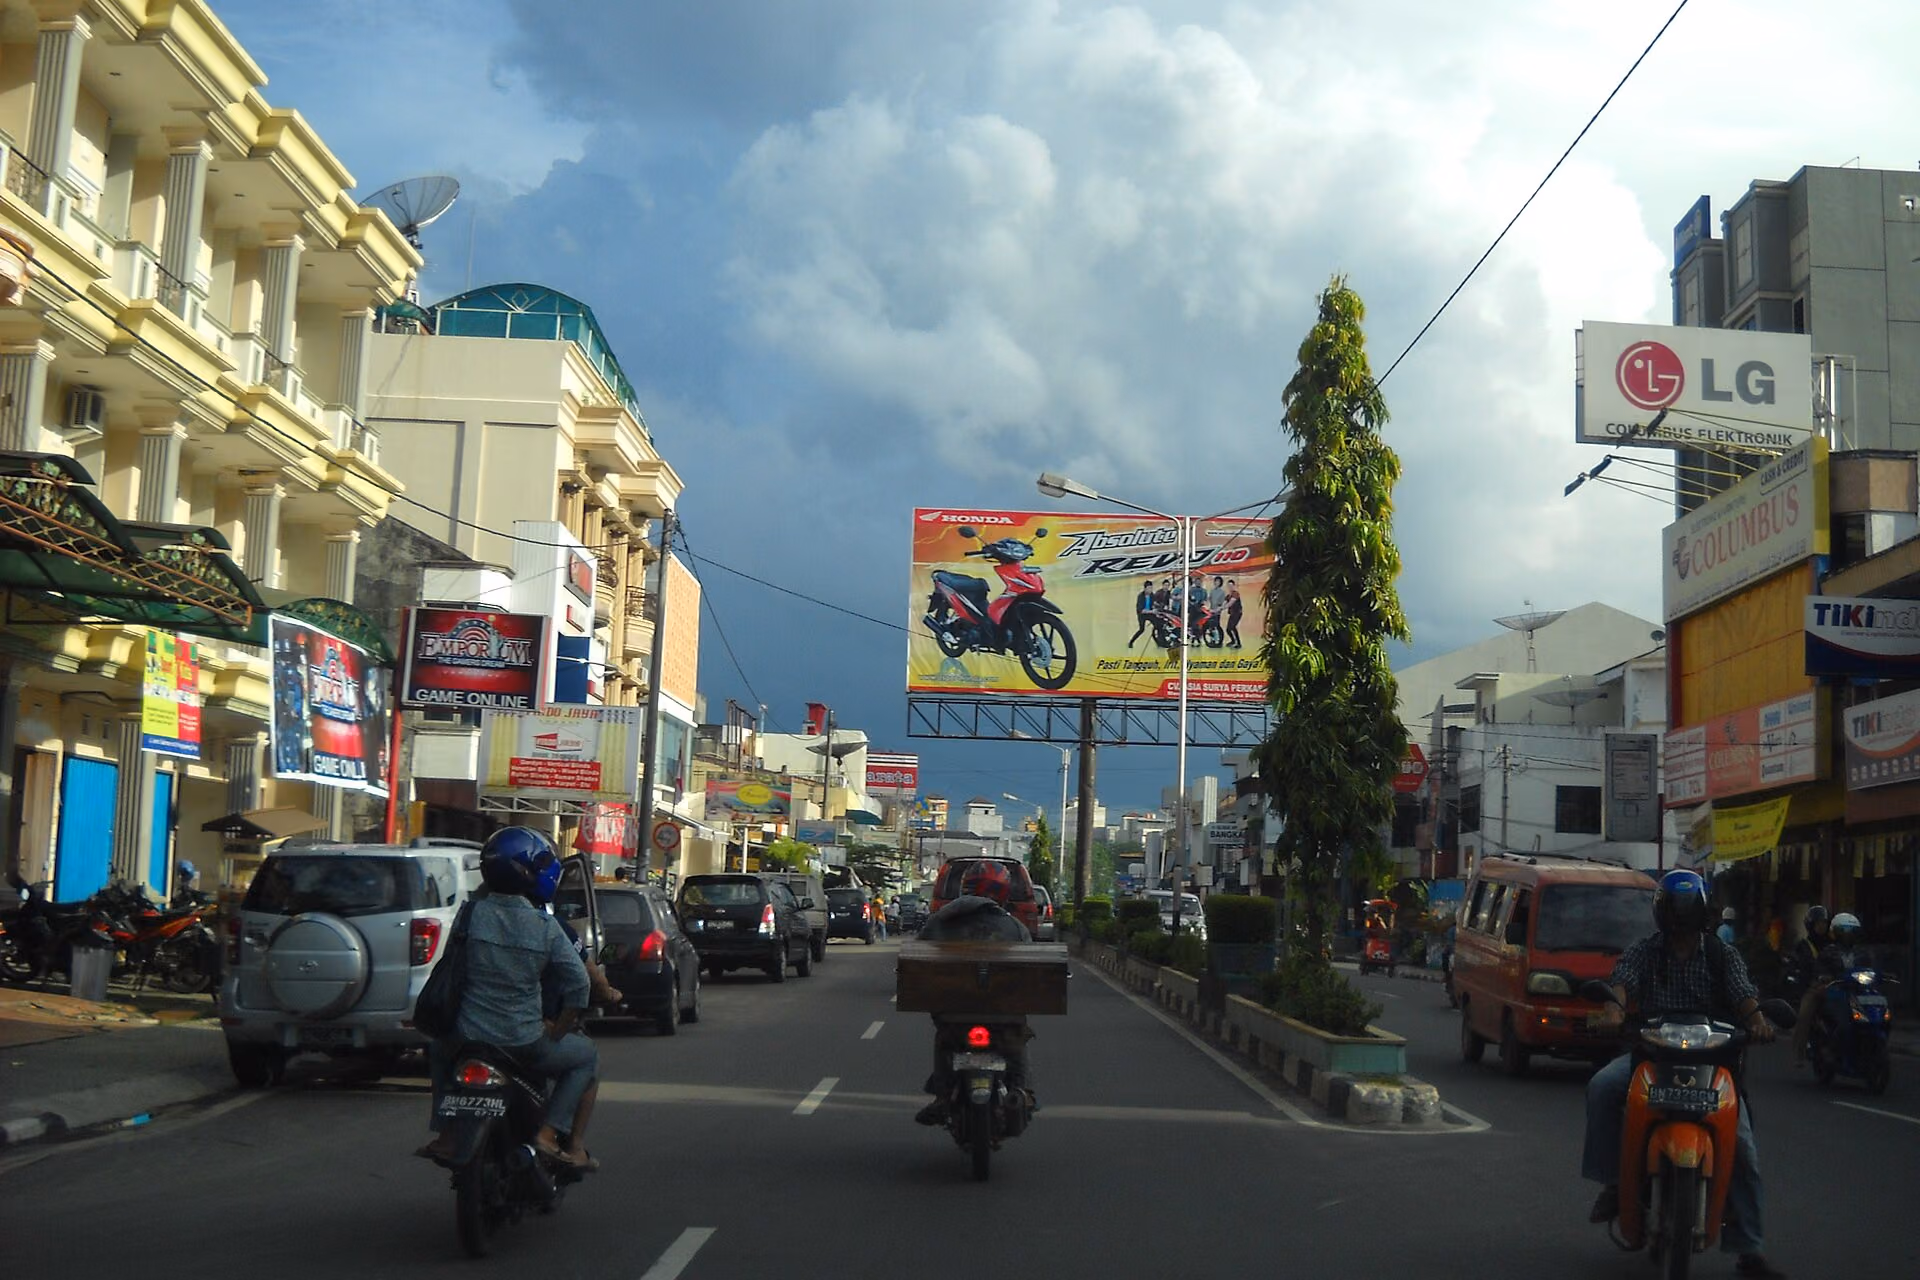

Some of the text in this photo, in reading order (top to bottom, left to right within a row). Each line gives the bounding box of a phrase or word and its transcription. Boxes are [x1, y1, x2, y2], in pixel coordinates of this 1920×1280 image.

[1701, 358, 1775, 405] LG
[1698, 429, 1792, 446] ELEKTRONIK
[941, 515, 1015, 524] HONDA
[1691, 484, 1799, 577] COLUMBUS
[1058, 528, 1178, 557] Absolute
[1080, 549, 1248, 575] REVO 110
[1097, 659, 1121, 670] Pasti
[1203, 682, 1230, 692] SURYA
[416, 689, 529, 708] GAME ONLINE
[313, 754, 341, 776] GAME
